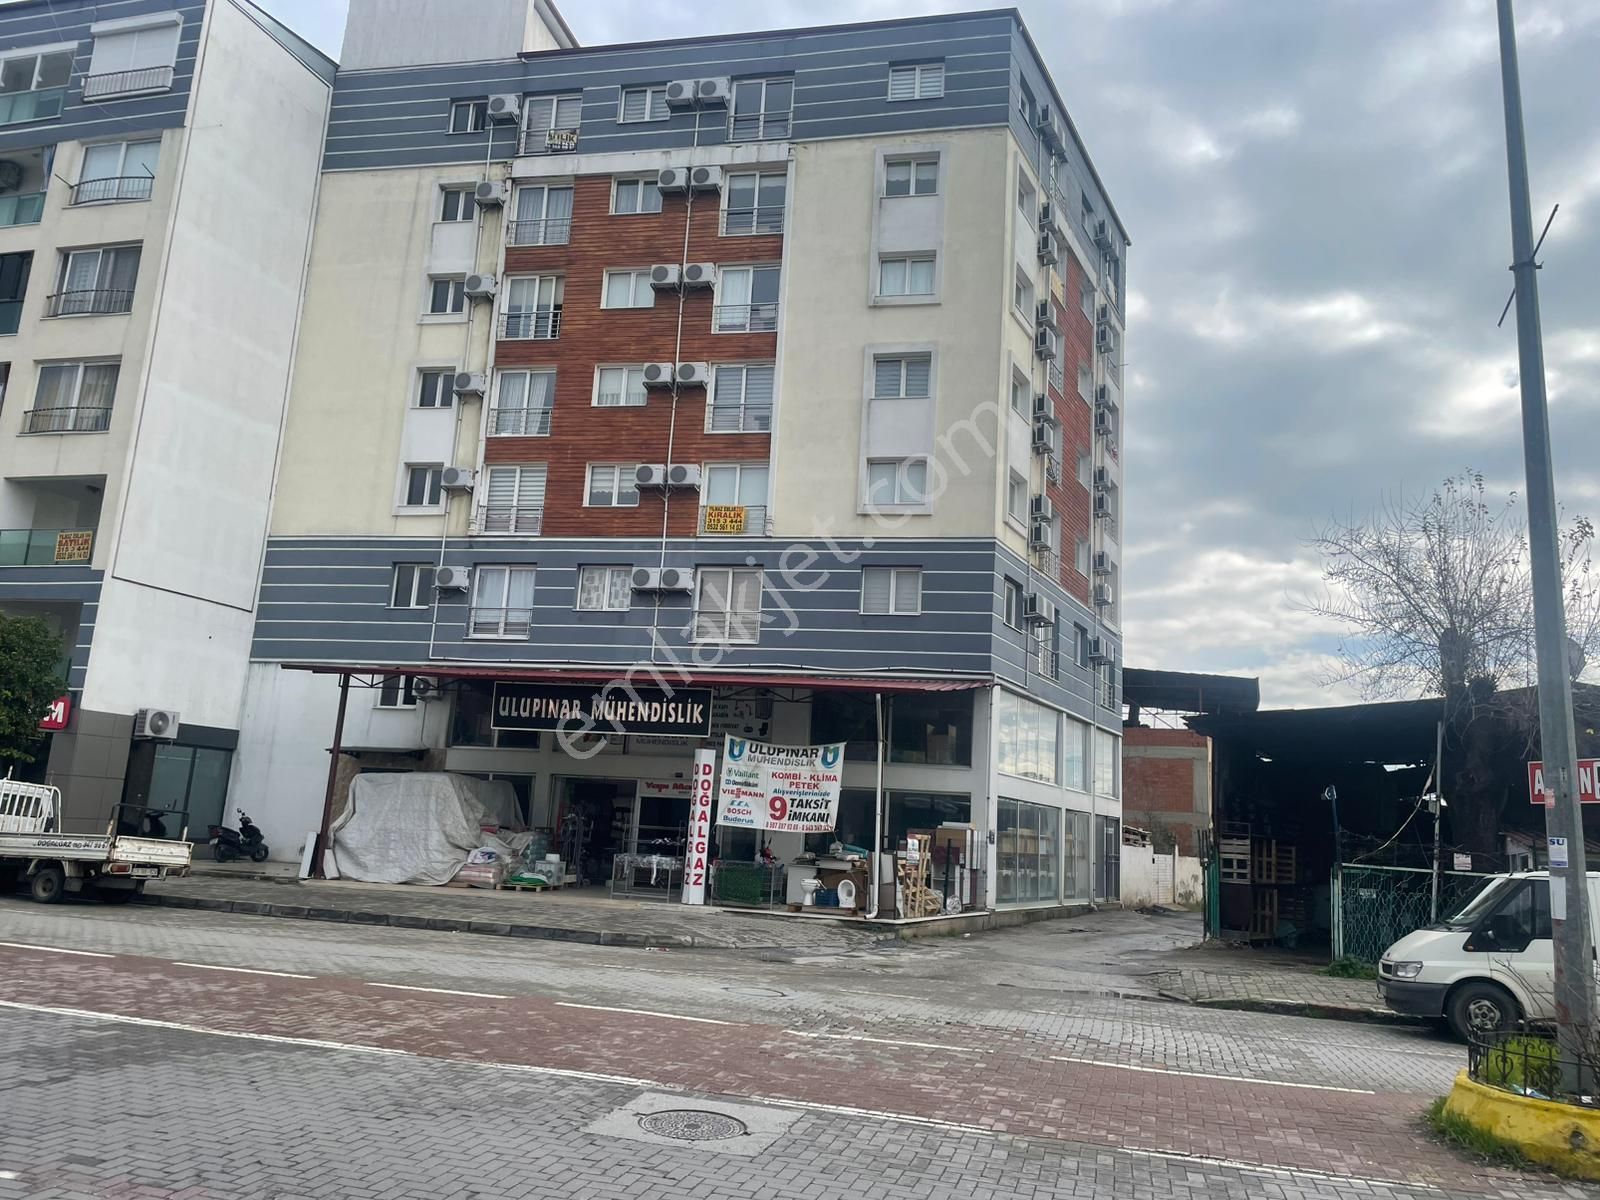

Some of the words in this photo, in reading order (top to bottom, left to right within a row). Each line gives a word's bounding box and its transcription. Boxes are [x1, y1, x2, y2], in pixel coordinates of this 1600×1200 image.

[500, 696, 581, 720] ULUPINAR
[591, 696, 704, 724] MÜHENDİSLİK
[749, 742, 820, 759] ULUPINAR
[734, 769, 759, 779] Vaillant
[771, 771, 801, 780] KOMBİ
[809, 773, 838, 782] KLİMA
[789, 781, 821, 790] PETEK
[768, 796, 788, 821] 9
[789, 797, 832, 810] TAKSİT
[727, 808, 752, 816] BOSCH
[787, 810, 830, 823] İMKANI
[684, 763, 700, 885] DOĞALGAZ
[692, 763, 713, 886] DOĞALGAZ
[723, 815, 754, 824] Buderus
[1549, 838, 1565, 846] SU
